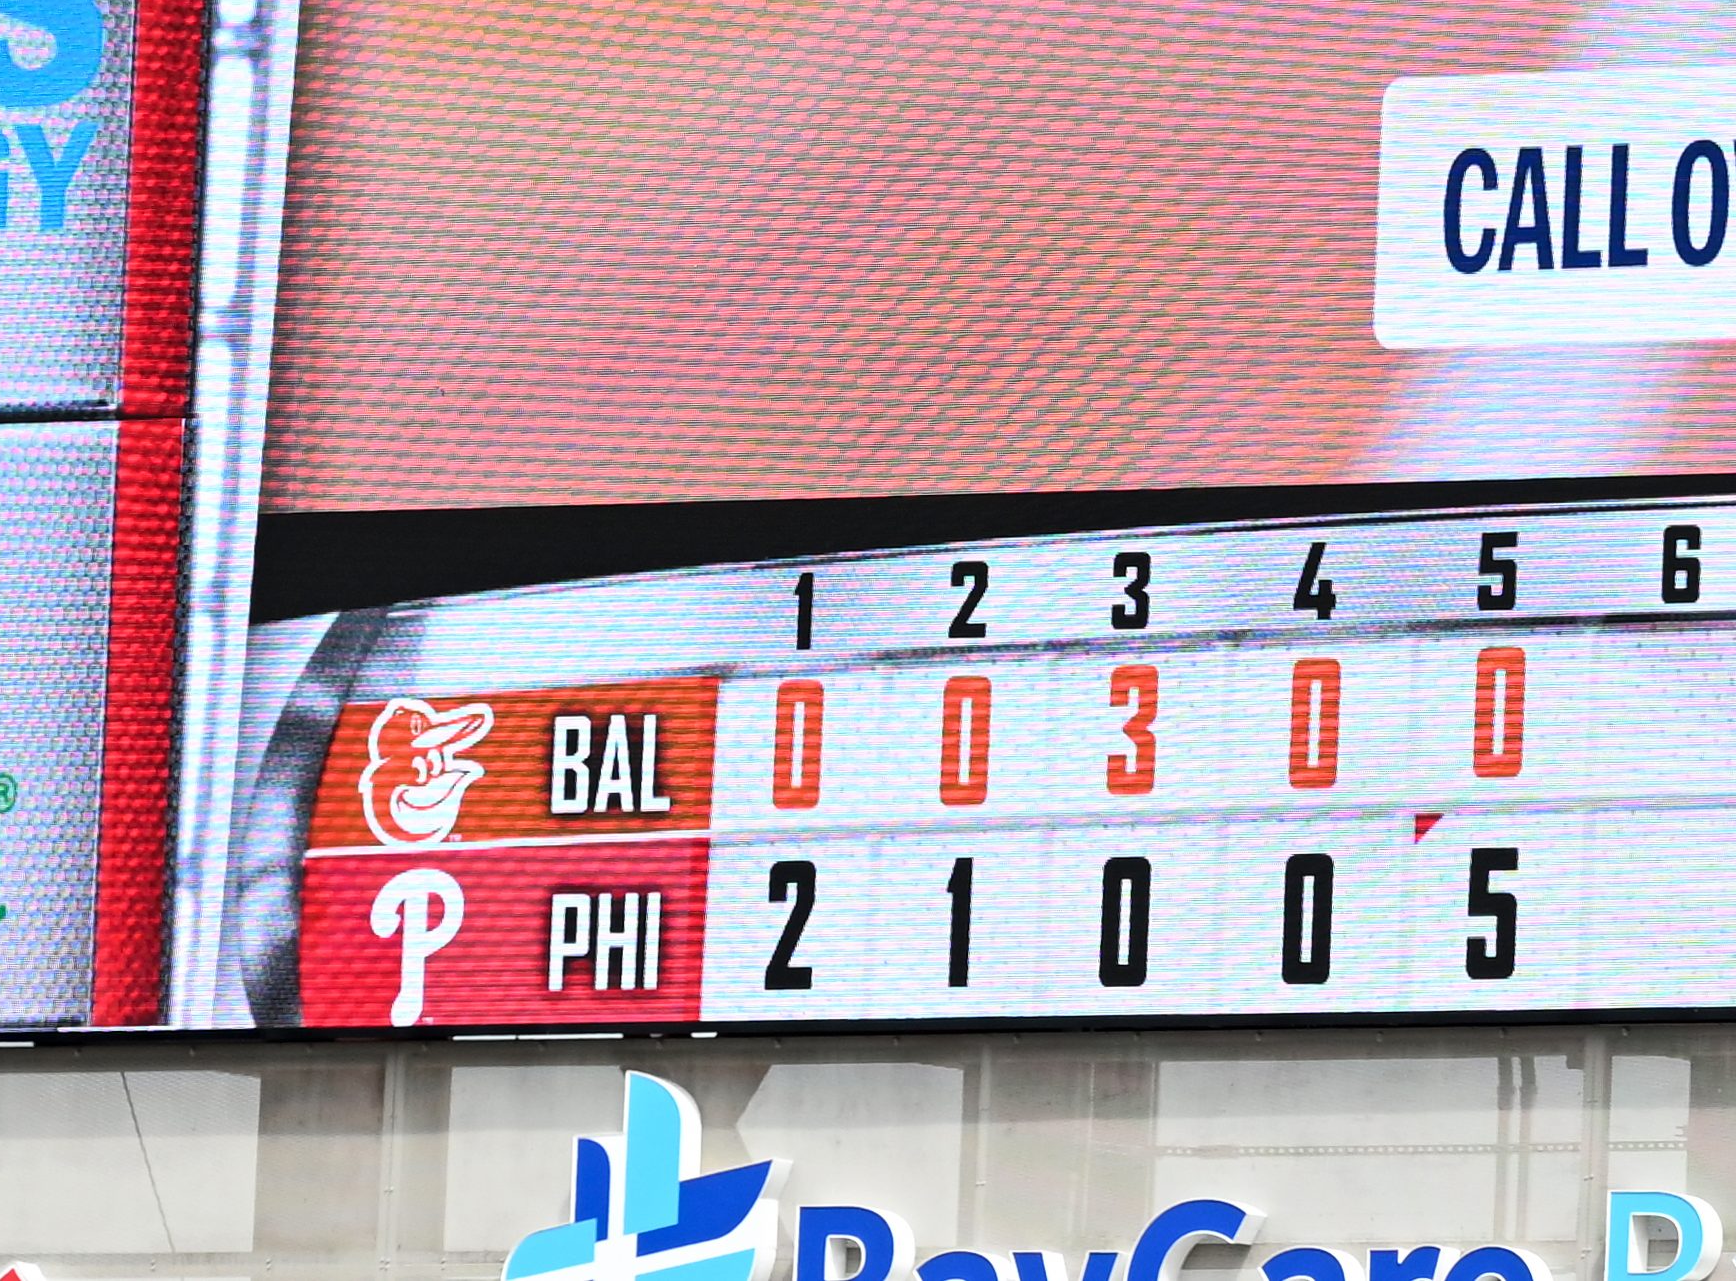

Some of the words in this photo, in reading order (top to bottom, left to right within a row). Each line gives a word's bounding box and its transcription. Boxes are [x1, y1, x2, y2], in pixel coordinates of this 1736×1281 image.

[1443, 144, 1649, 275] CALL
[795, 573, 814, 650] 1
[949, 561, 989, 638] 2
[1111, 552, 1151, 629] 3
[1294, 542, 1337, 620] 4
[1477, 532, 1518, 611] 5
[1663, 525, 1701, 603] 6
[551, 714, 670, 814] BAL
[773, 679, 823, 809] 0
[940, 676, 992, 805] 0
[1107, 665, 1158, 794] 3
[1289, 658, 1341, 788] 0
[1473, 647, 1525, 777] 0
[549, 893, 661, 991] PHI
[764, 860, 817, 990] 2
[948, 858, 974, 987] 1
[1099, 857, 1152, 987] 0
[1282, 854, 1334, 984] 0
[1466, 847, 1519, 979] 5
